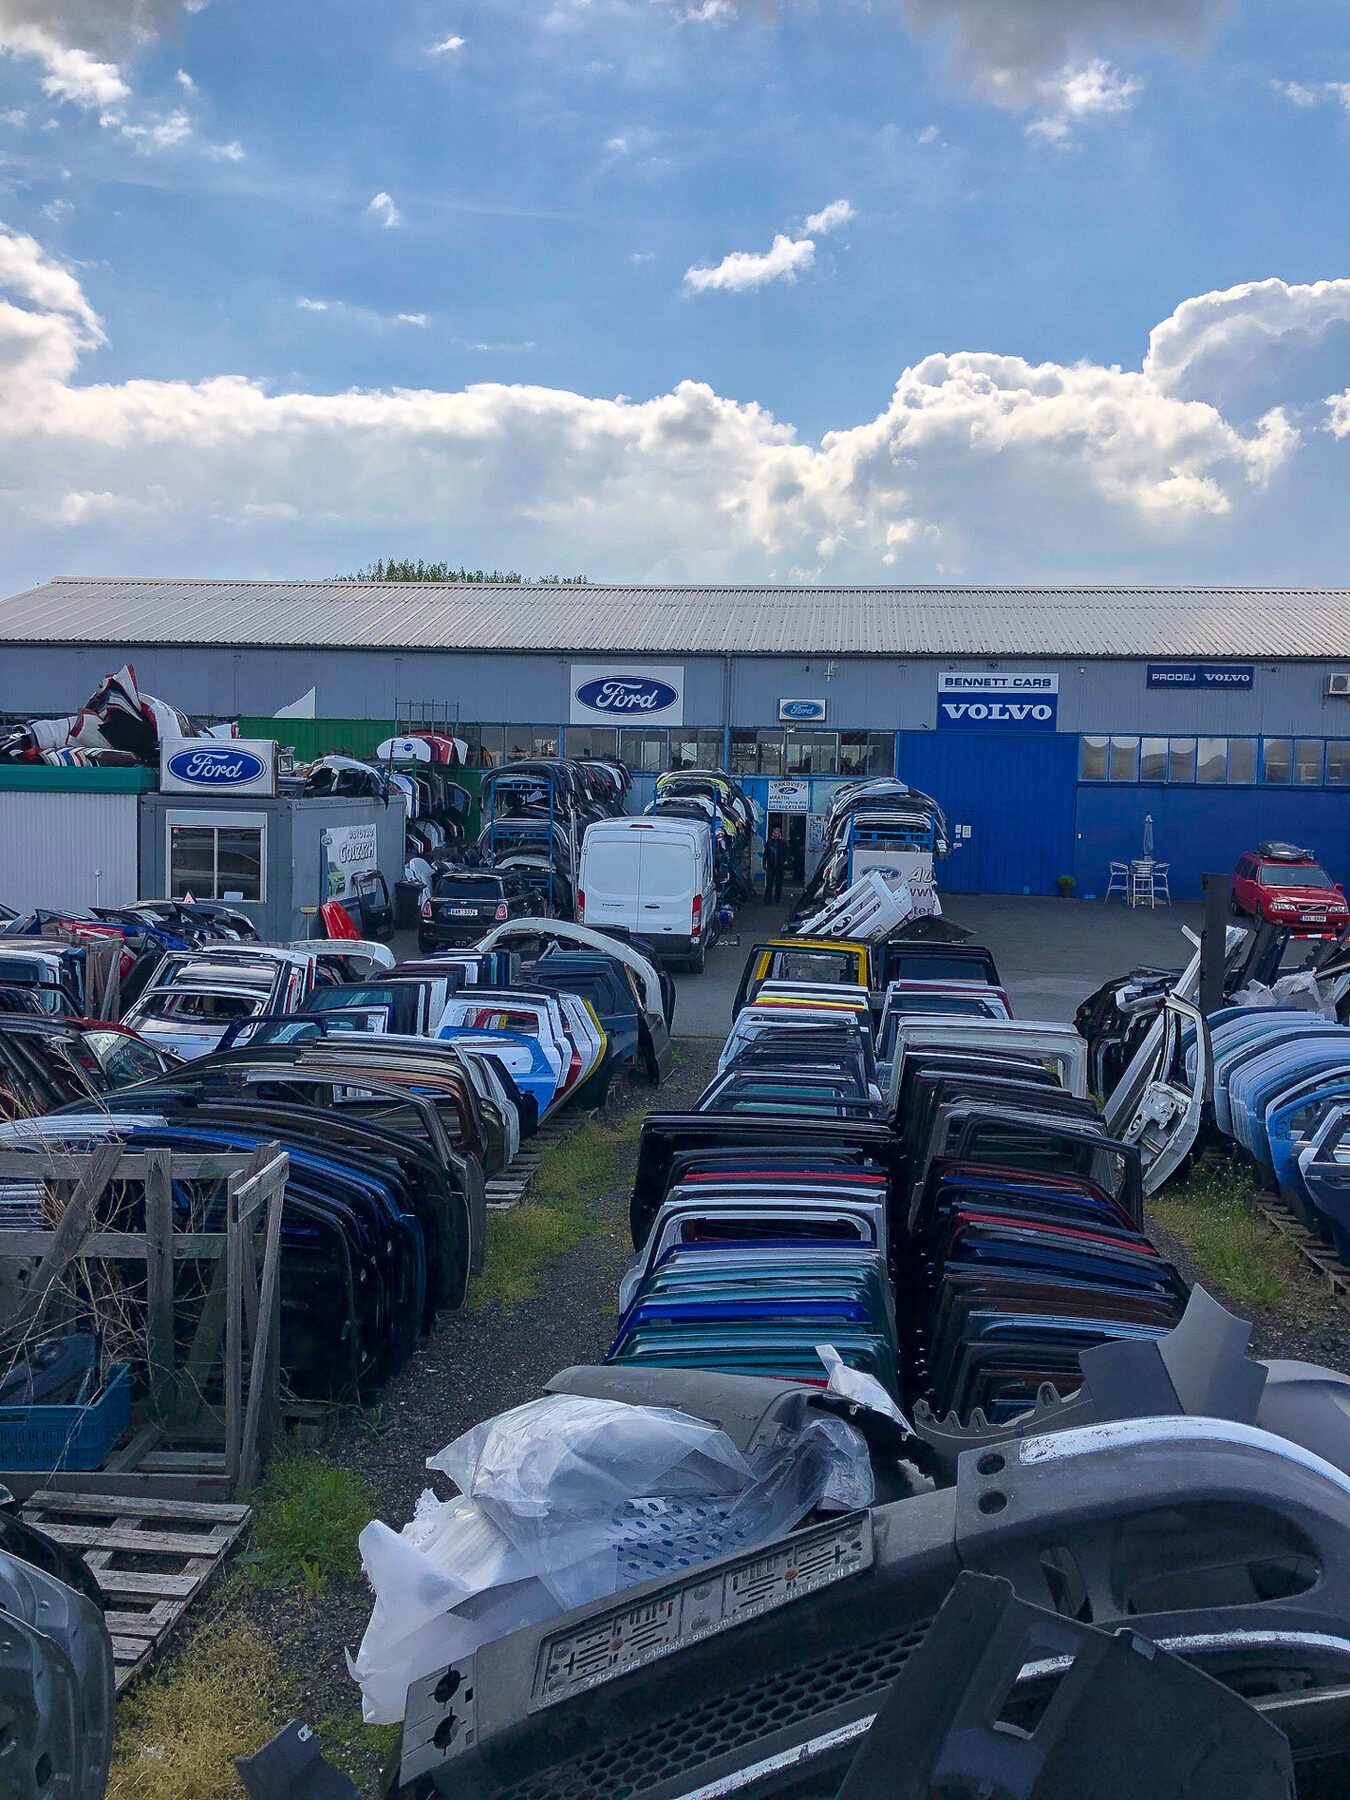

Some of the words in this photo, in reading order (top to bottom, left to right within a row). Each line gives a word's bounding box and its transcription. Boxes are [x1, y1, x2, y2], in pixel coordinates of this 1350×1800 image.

[944, 677, 1008, 686] BENNETT
[1013, 678, 1052, 687] CARS
[1152, 673, 1196, 681] PRODEJ
[1204, 673, 1250, 682] VOLVO
[595, 681, 658, 709] Ford
[790, 703, 815, 715] Ford
[941, 703, 1053, 720] VOLVO
[186, 753, 243, 778] Ford
